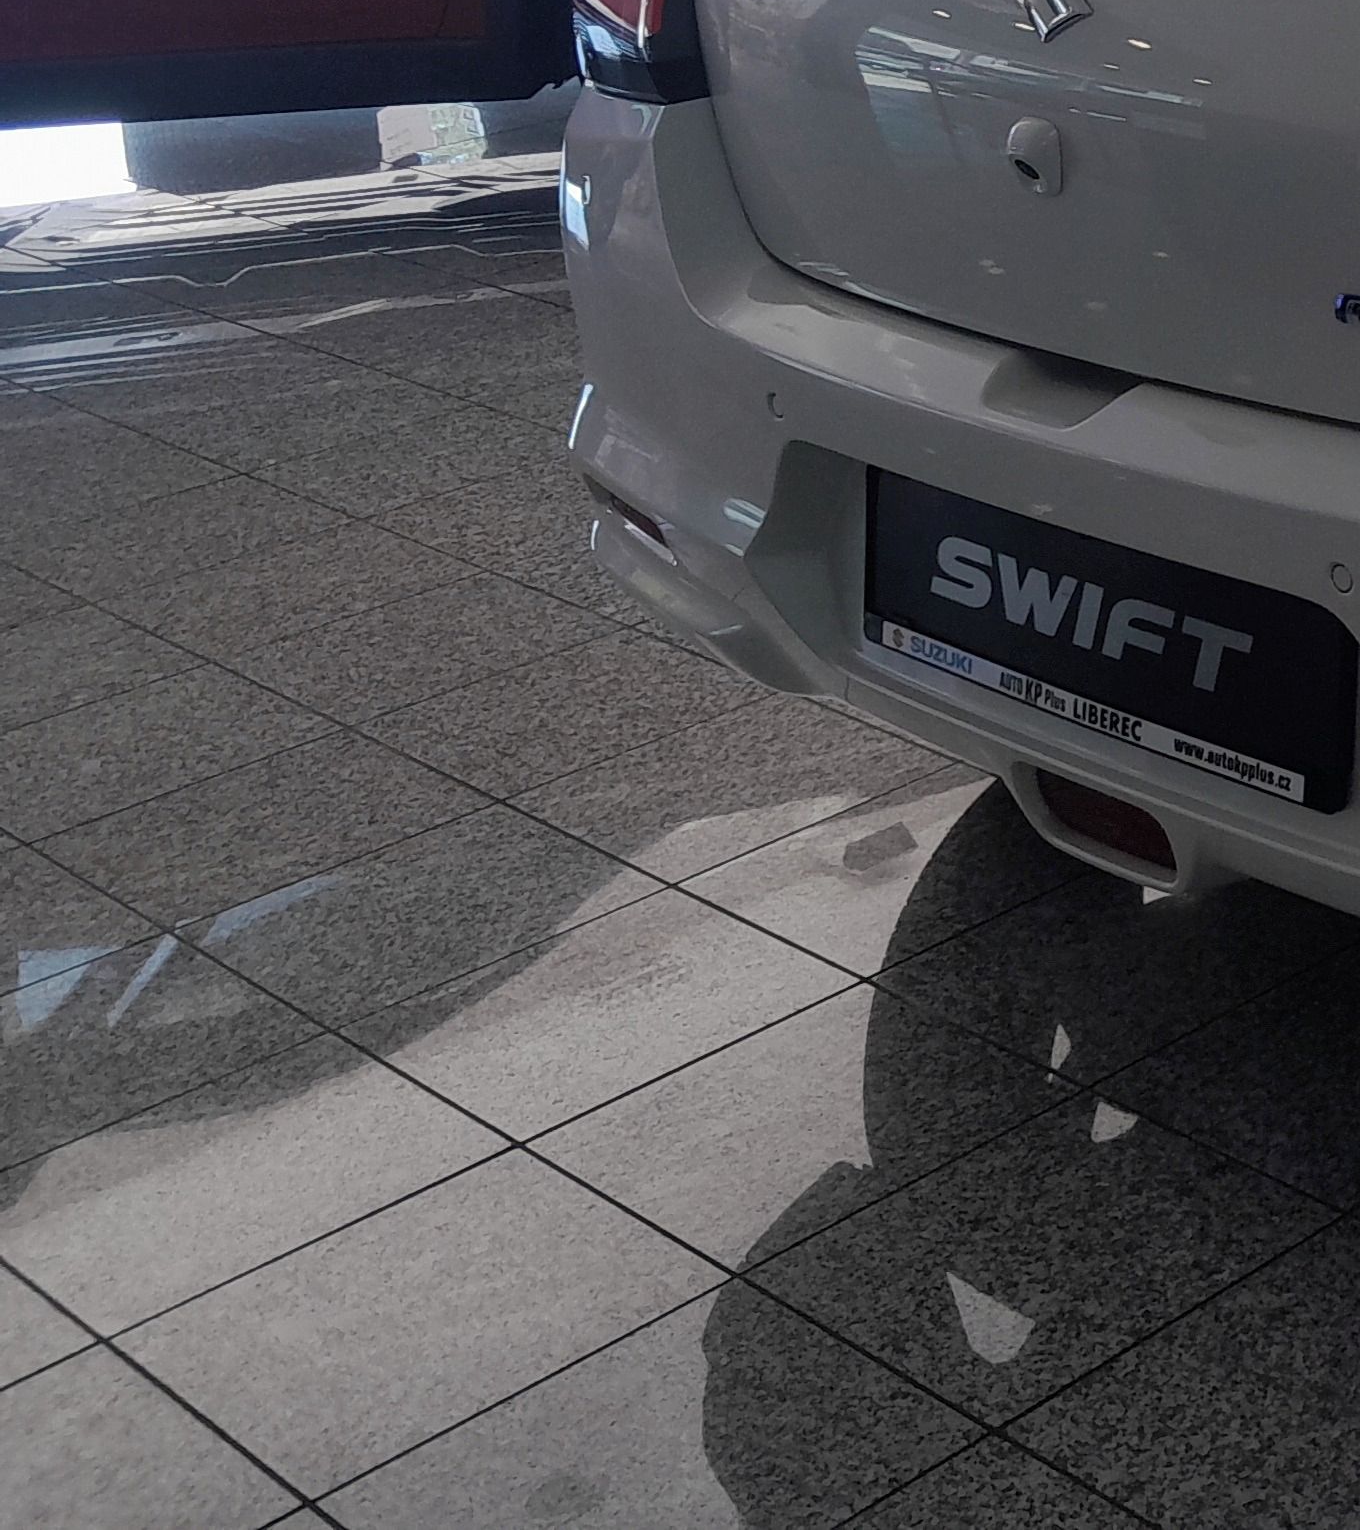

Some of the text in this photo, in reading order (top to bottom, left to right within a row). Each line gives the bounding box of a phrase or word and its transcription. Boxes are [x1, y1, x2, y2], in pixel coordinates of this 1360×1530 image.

[930, 534, 1254, 692] SWIFT
[909, 635, 973, 675] SUZUKI
[1025, 679, 1043, 704] KP
[1072, 697, 1143, 741] LIBEREC
[1173, 737, 1291, 792] www.autokpplus.cz
